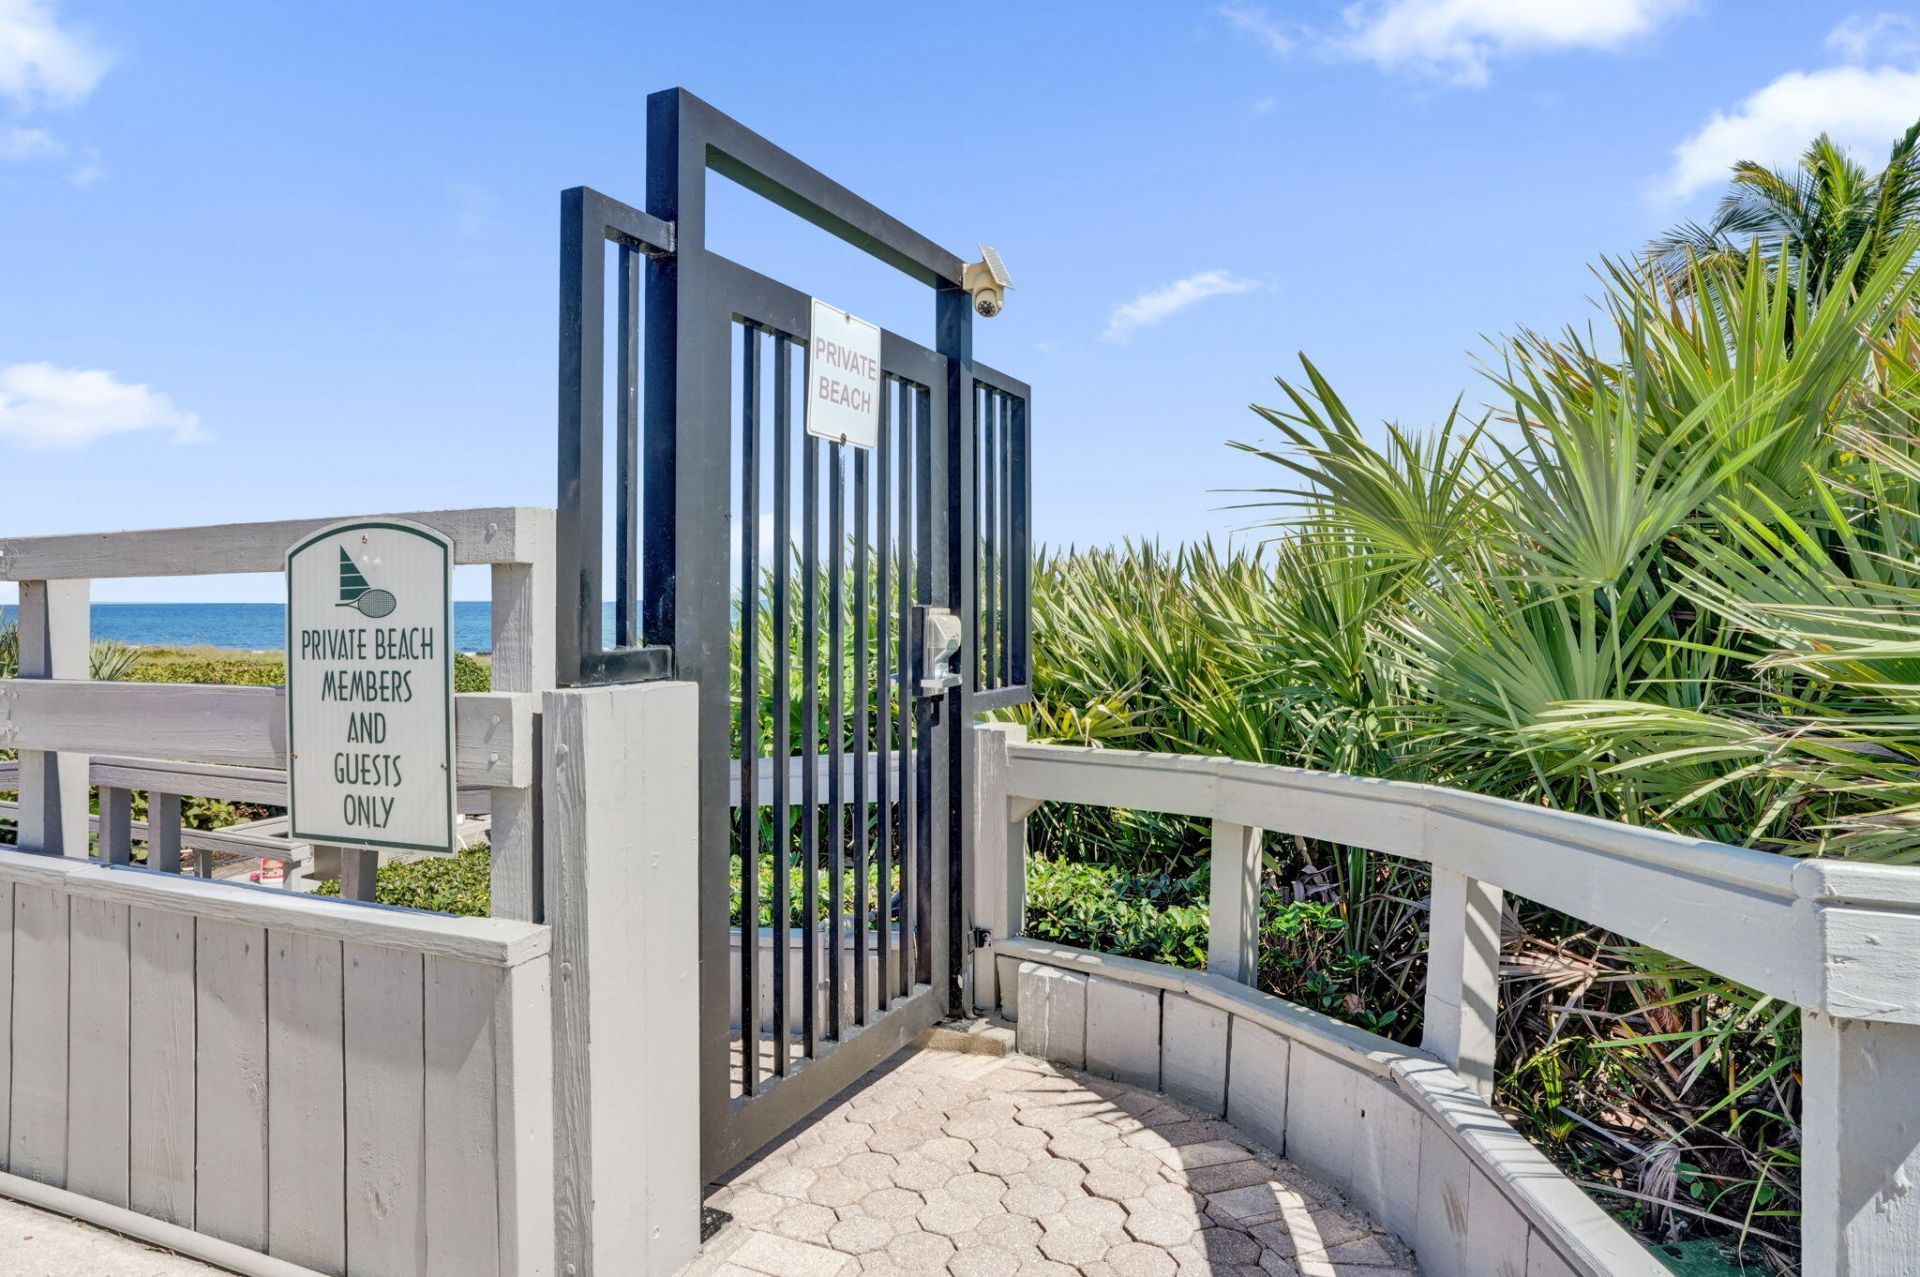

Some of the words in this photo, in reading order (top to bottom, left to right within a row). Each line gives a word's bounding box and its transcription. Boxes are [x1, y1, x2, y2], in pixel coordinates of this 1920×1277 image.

[815, 336, 877, 381] PRIVATE
[819, 376, 871, 414] BEACH
[301, 628, 367, 660] PRIVATE
[375, 627, 434, 660] BEACH
[321, 669, 413, 703] MEMBERS
[347, 711, 387, 744] AND
[334, 752, 402, 787] GUESTS
[343, 794, 395, 829] ONLY
